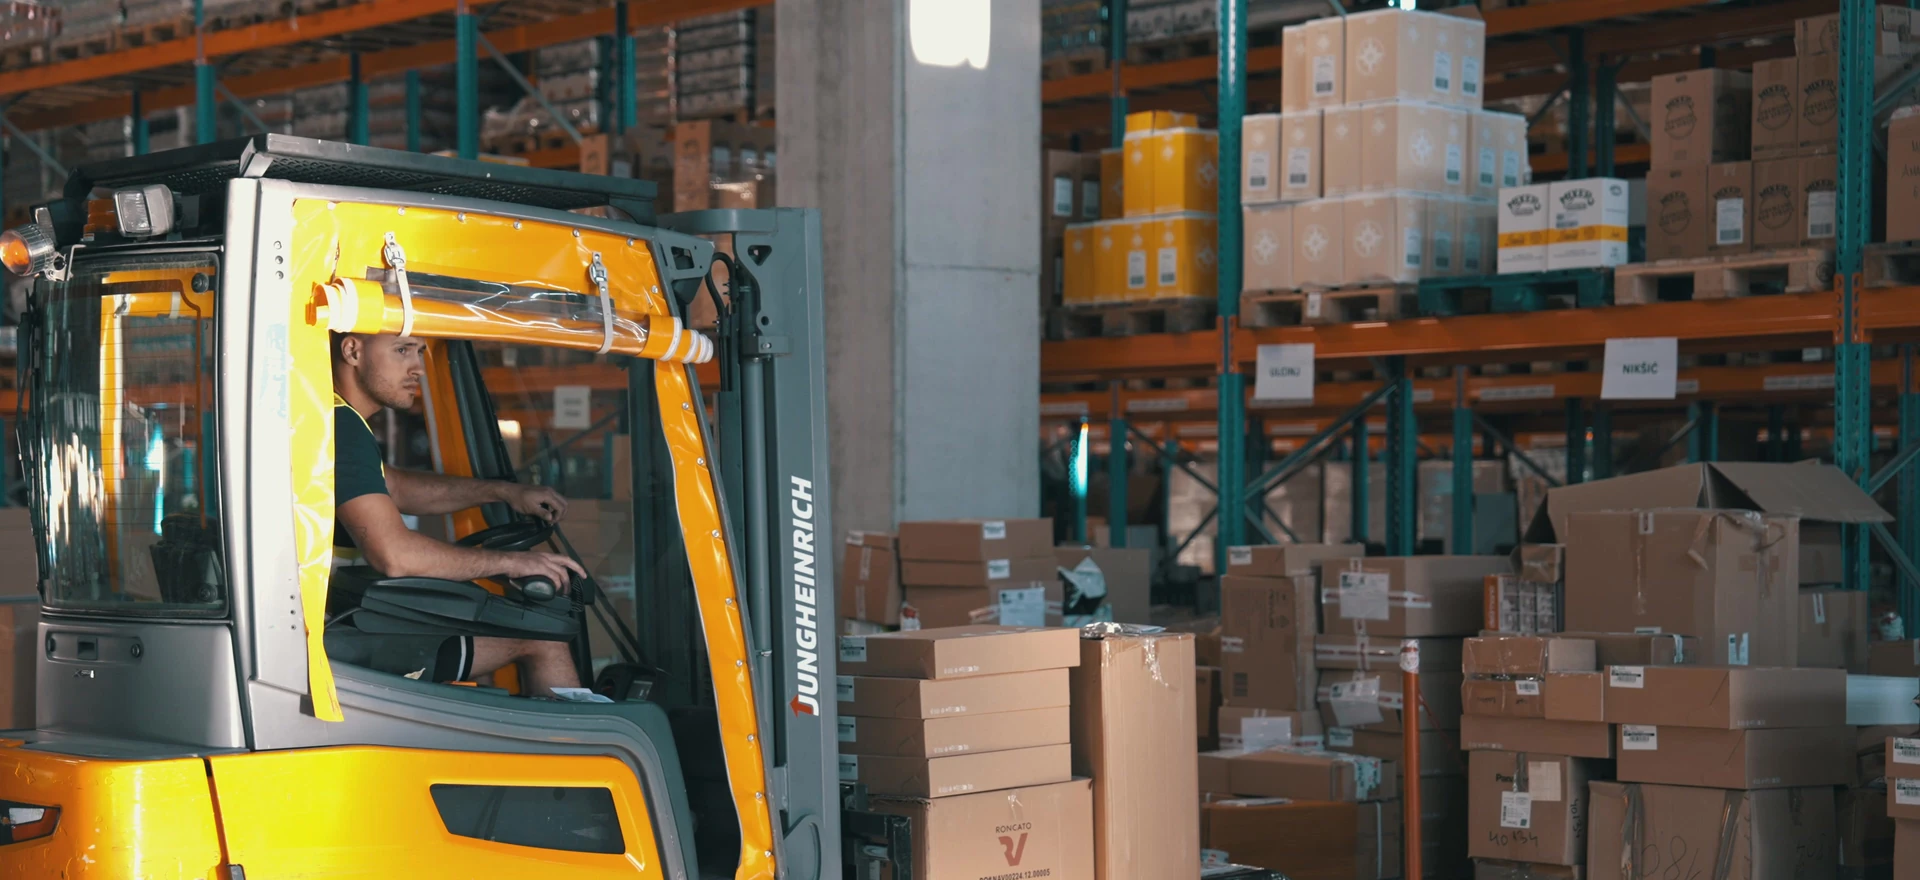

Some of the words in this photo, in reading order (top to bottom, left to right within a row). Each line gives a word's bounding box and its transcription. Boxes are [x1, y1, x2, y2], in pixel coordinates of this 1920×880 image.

[1622, 361, 1659, 375] NIKŠIĆ
[790, 475, 819, 716] JUNGHEINRICH
[995, 822, 1032, 834] RONCATO
